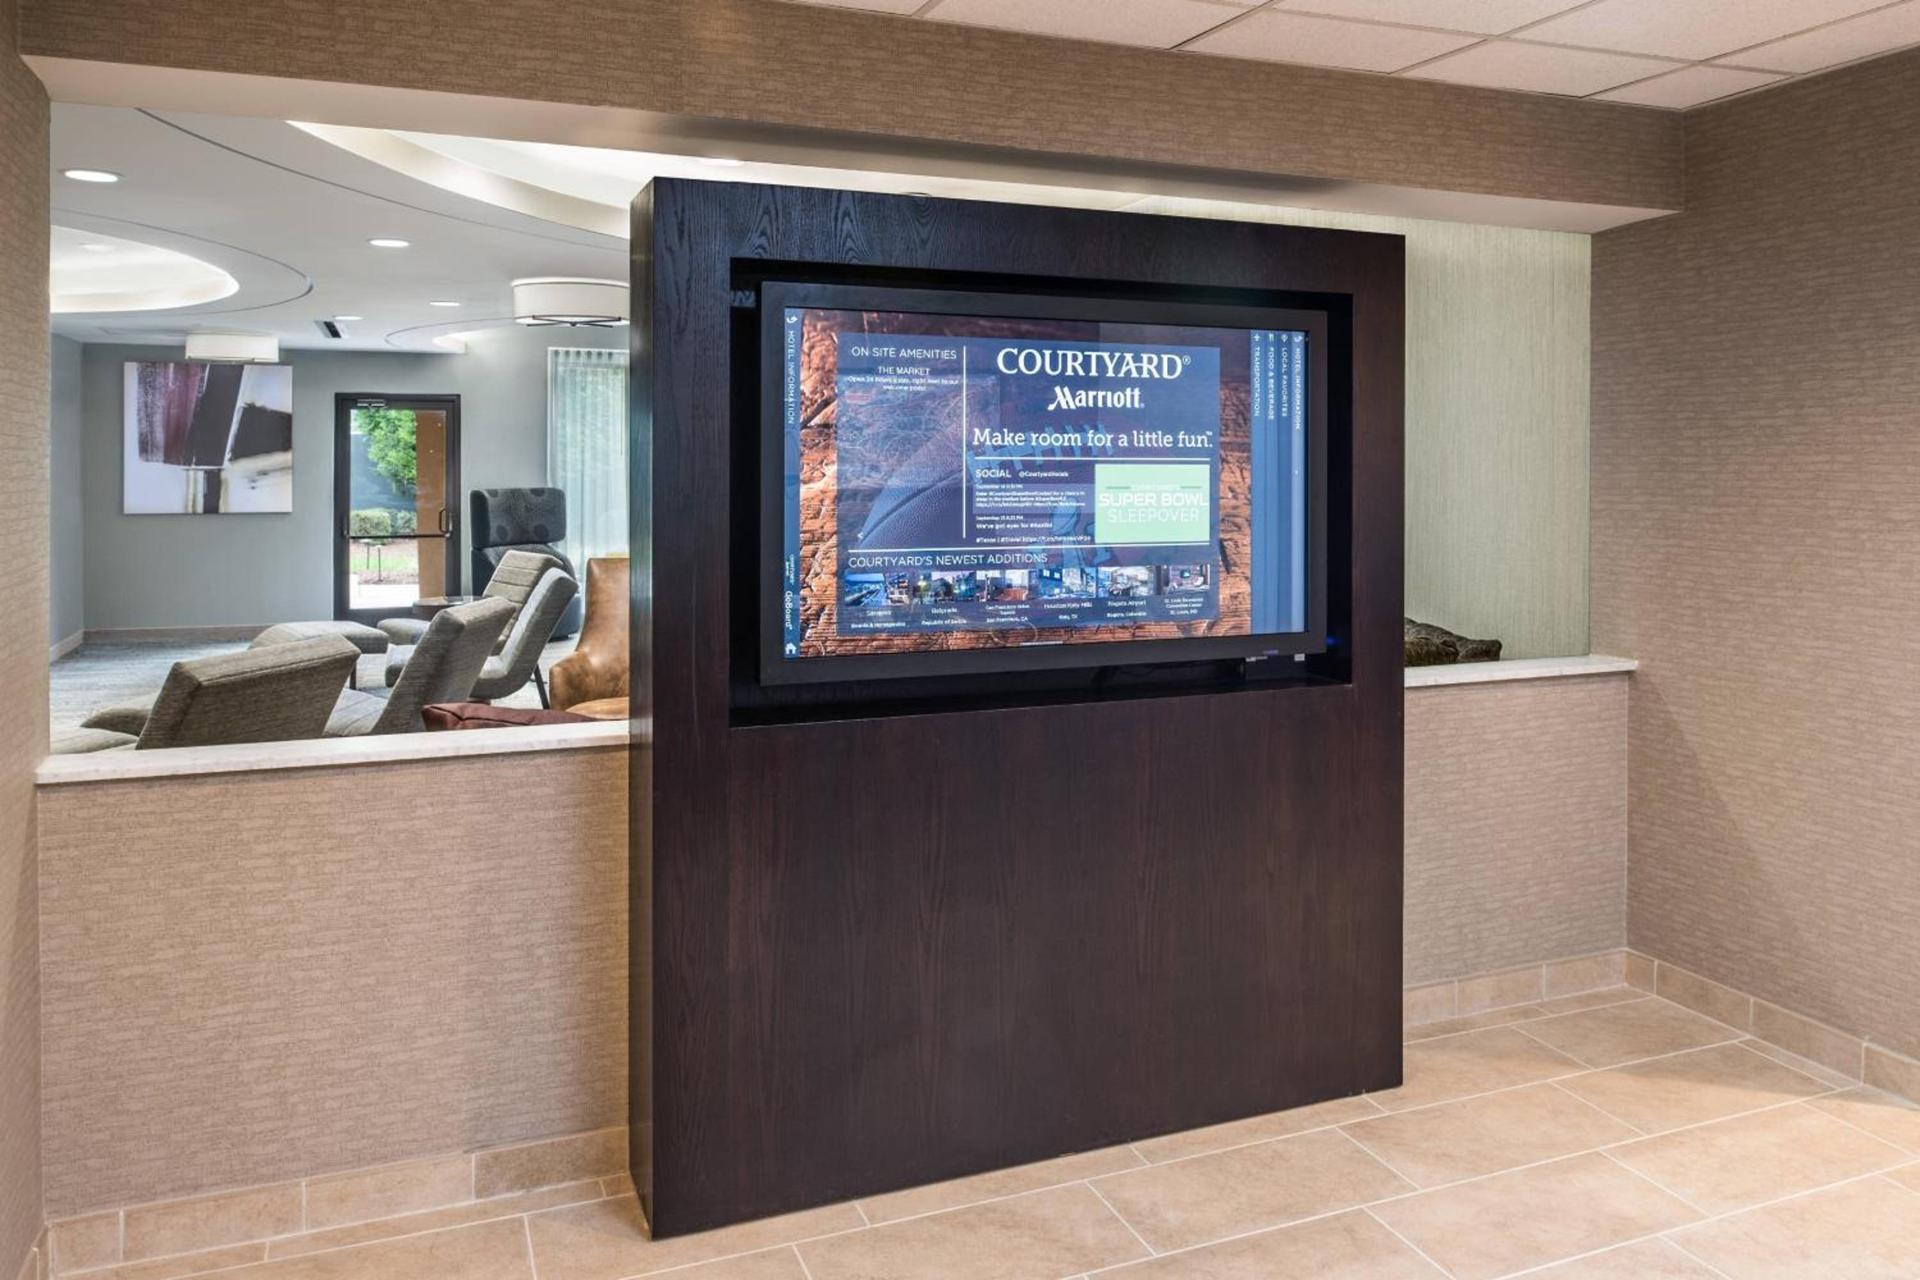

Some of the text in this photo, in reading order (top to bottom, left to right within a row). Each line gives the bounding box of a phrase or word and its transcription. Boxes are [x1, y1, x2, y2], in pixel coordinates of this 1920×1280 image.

[851, 346, 956, 360] ON SITE AMENITIES
[878, 366, 930, 376] THE MARKET
[972, 428, 1025, 446] Make
[1030, 432, 1082, 446] room
[1088, 430, 1114, 446] for
[1118, 434, 1128, 446] a
[1132, 430, 1174, 447] little
[976, 468, 1012, 478] SOCIAL
[1099, 492, 1209, 506] SUPER BOWL
[1108, 508, 1200, 523] SLEEPOVER
[848, 554, 1048, 568] COURTYARD'S NEWEST ADDITIONS
